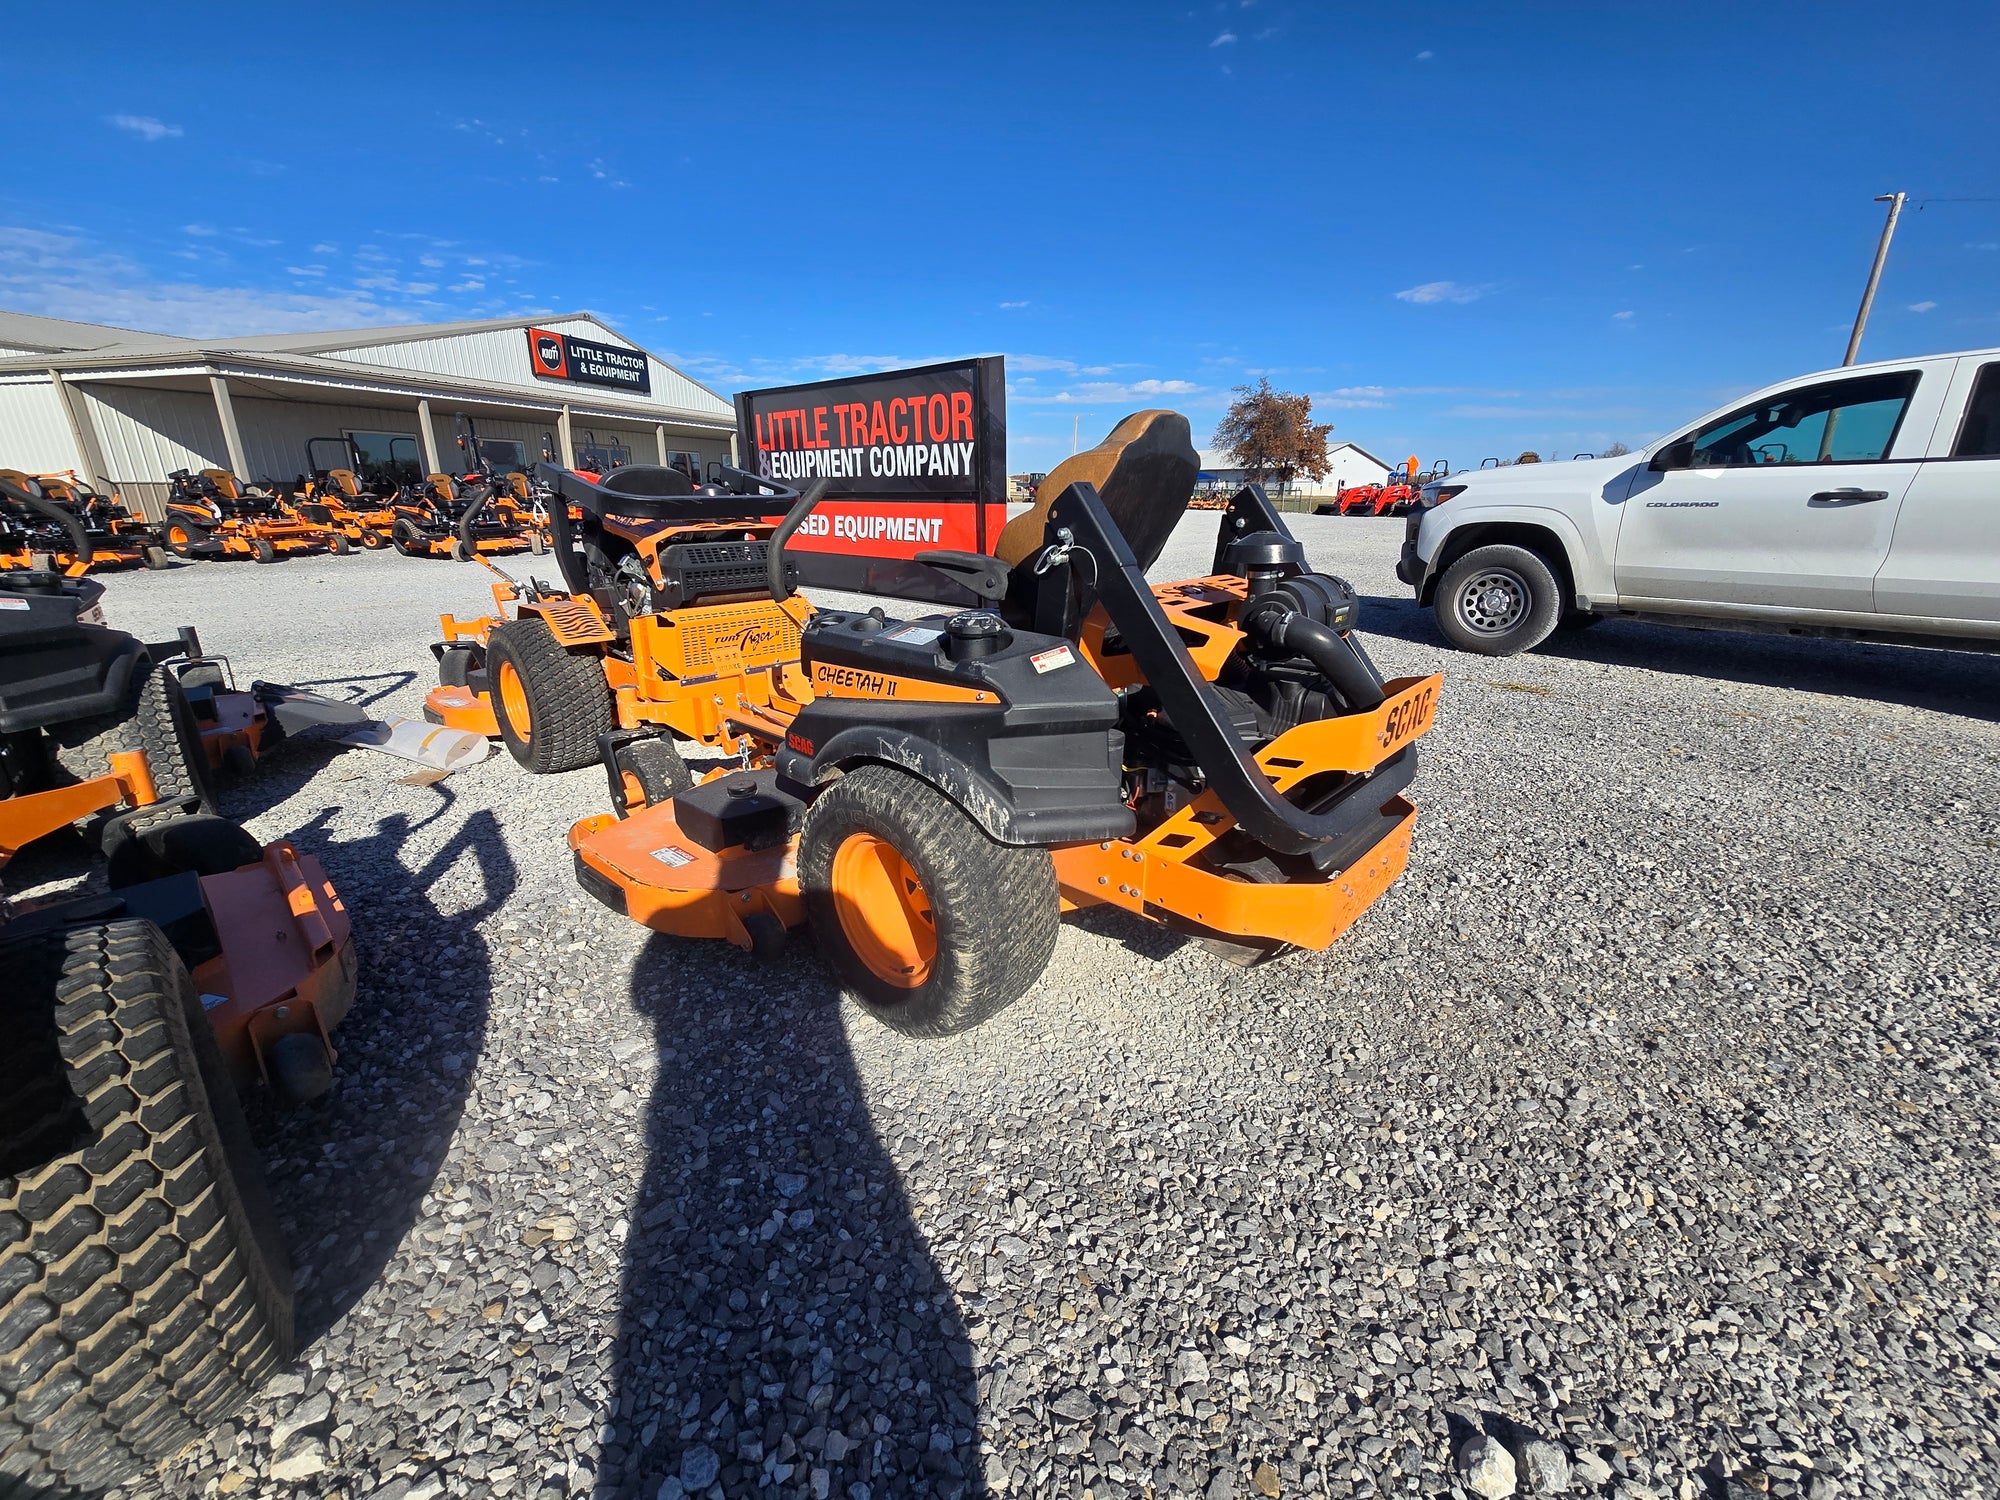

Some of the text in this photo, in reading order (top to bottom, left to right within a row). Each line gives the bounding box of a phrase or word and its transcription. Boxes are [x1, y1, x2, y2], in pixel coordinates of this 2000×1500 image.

[570, 345, 645, 370] LITTLE TRACTOR
[580, 362, 640, 382] & EQUIPMENT
[755, 391, 974, 452] LITTLE TRACTOR
[771, 447, 864, 480] EQUIPMENT
[869, 442, 975, 477] COMPANY
[793, 514, 943, 543] SED EQUIPMENT
[817, 666, 898, 697] CHEETAH II
[1382, 687, 1433, 749] SCAG
[788, 733, 814, 756] SCAG
